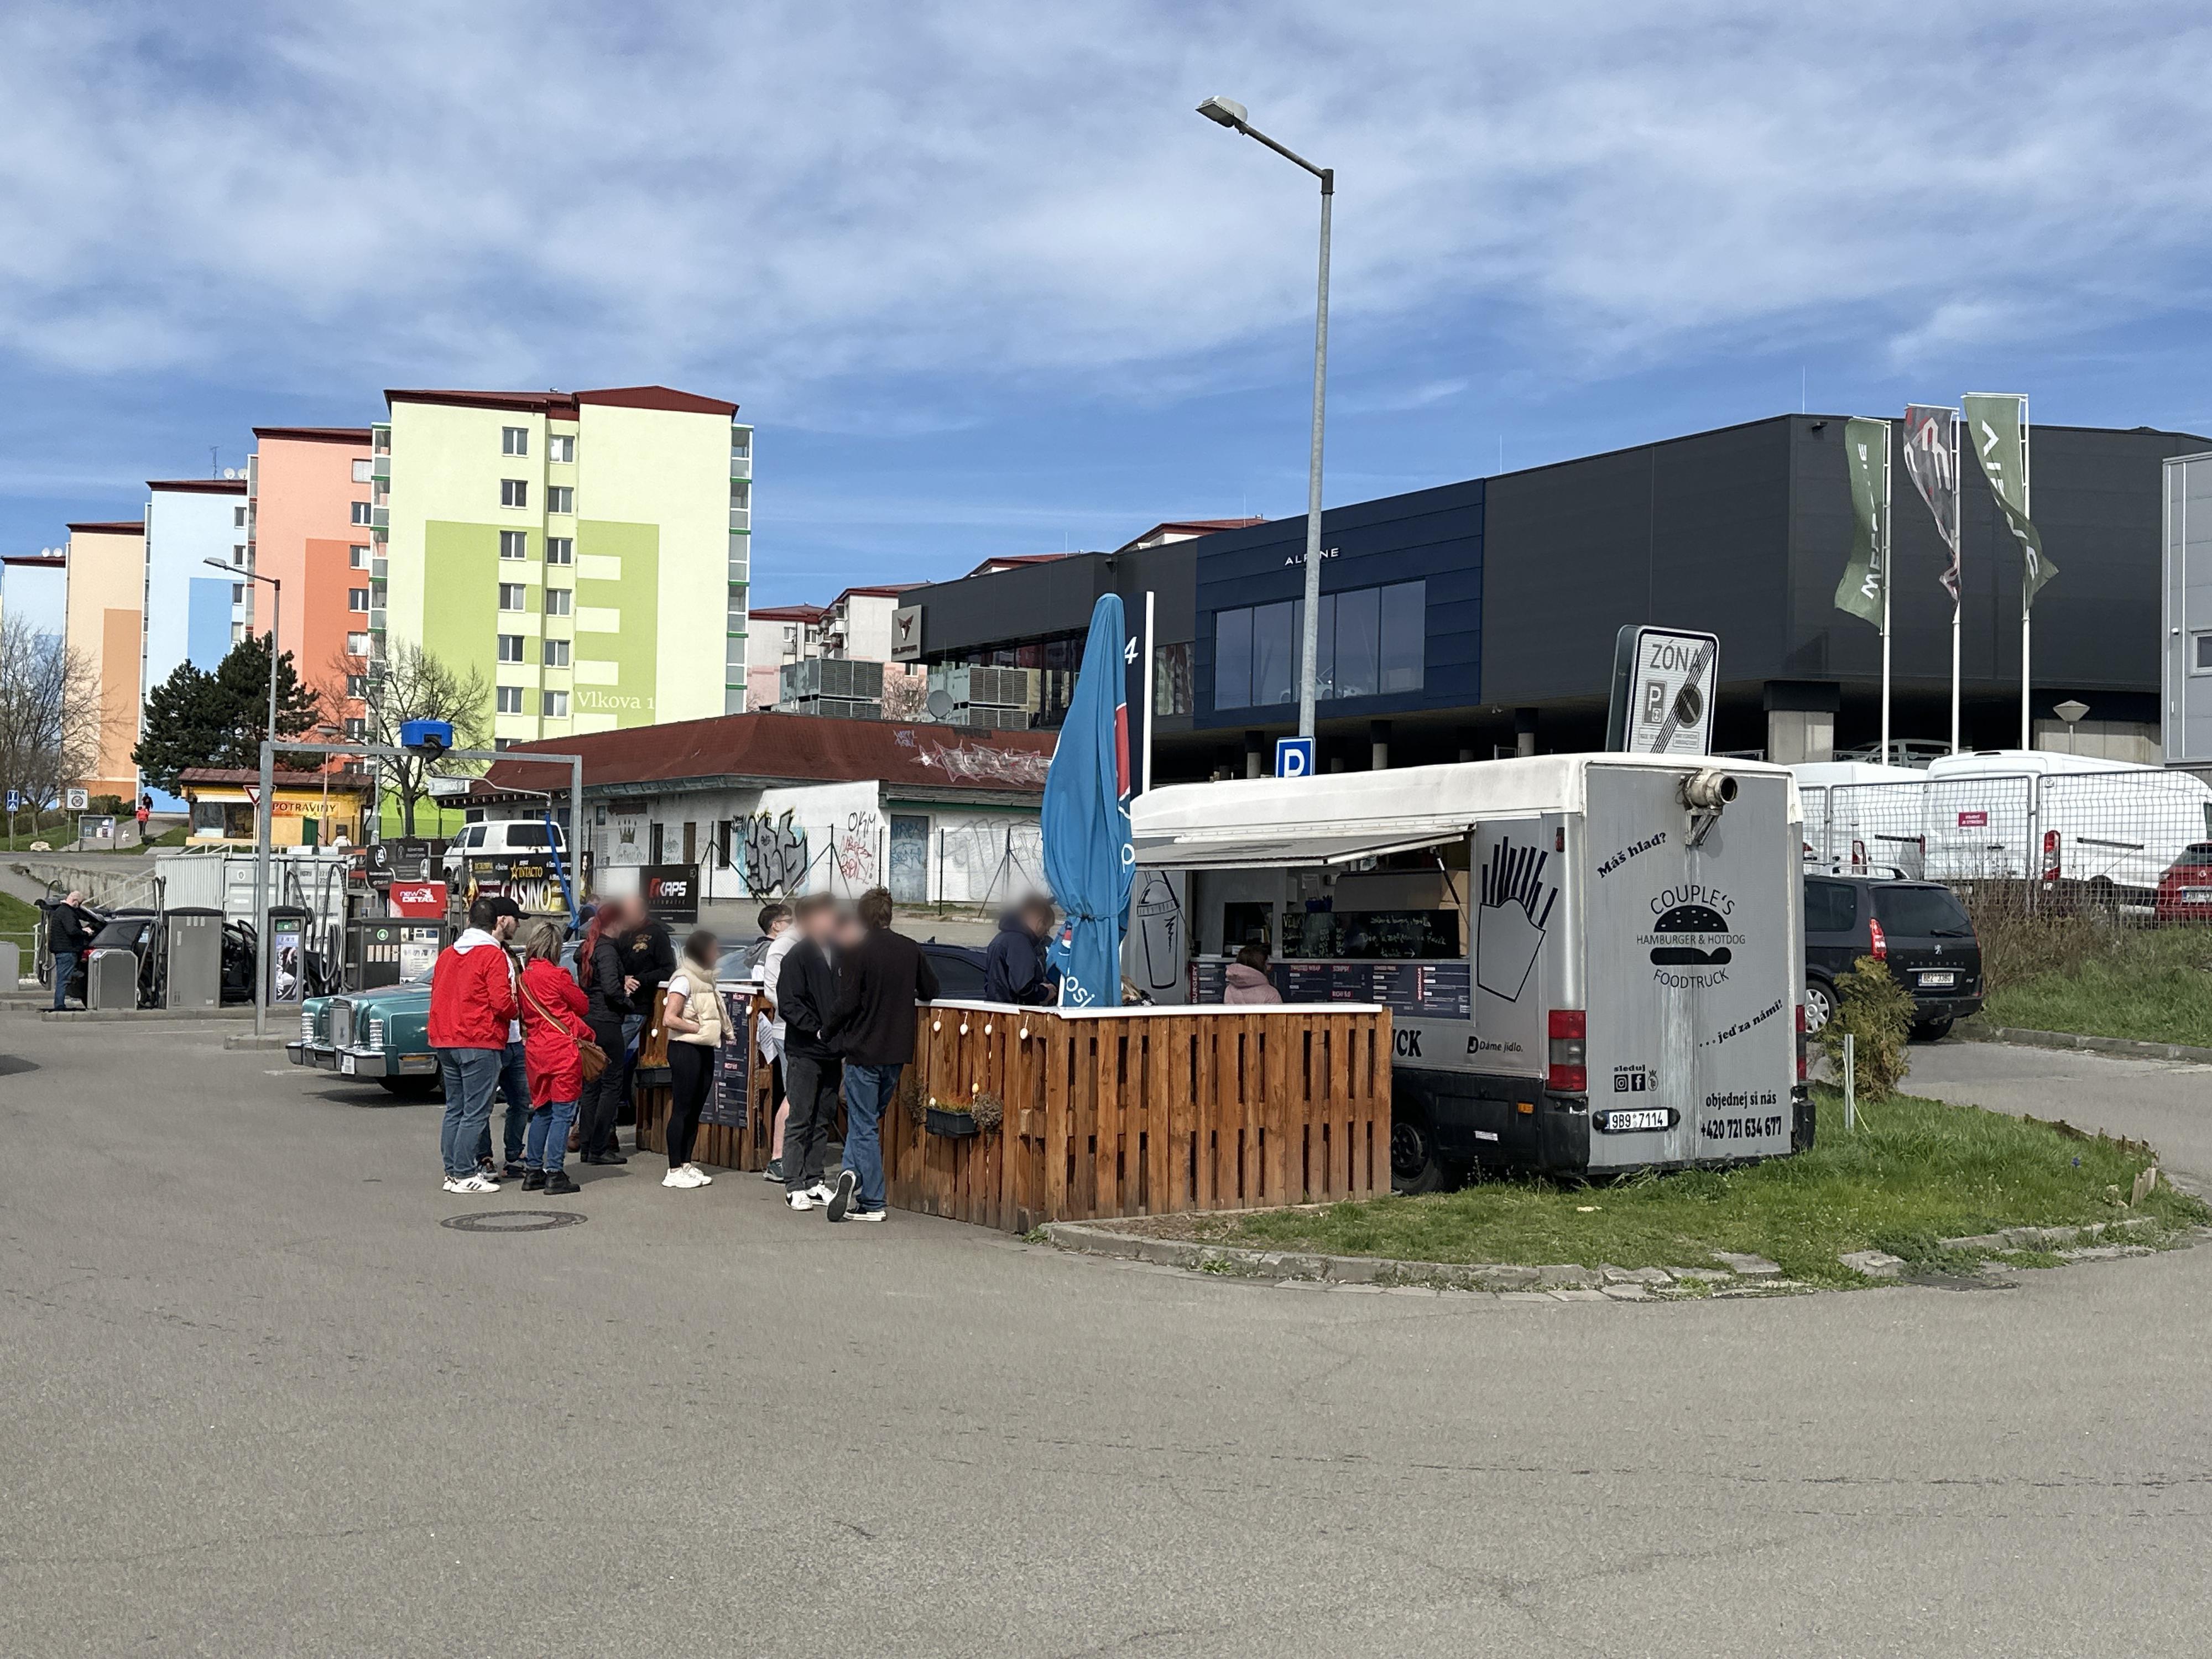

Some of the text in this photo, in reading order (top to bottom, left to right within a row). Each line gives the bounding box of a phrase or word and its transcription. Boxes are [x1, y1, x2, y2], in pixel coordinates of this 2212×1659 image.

[1285, 548, 1339, 565] ALPNE
[1650, 639, 1700, 671] ZÓNA
[577, 691, 655, 709] Vlkova 1
[1648, 686, 1661, 711] P
[1284, 749, 1305, 778] P
[272, 802, 336, 812] POTRAVINY
[1597, 832, 1666, 878] Máš hlad?
[500, 879, 551, 912] CASINO
[1637, 935, 1746, 945] HAMBURGER & HOTDOG
[1653, 968, 1729, 989] FOODTRUCK
[1738, 1022, 1751, 1032] za
[1752, 999, 1783, 1025] námi!
[1480, 1041, 1502, 1051] Dáme
[1504, 1041, 1524, 1053] jídlo.
[1706, 1089, 1777, 1110] objednej si nás
[1612, 1112, 1663, 1128] 9B9 7114
[1701, 1116, 1781, 1139] +420 721 634 677
